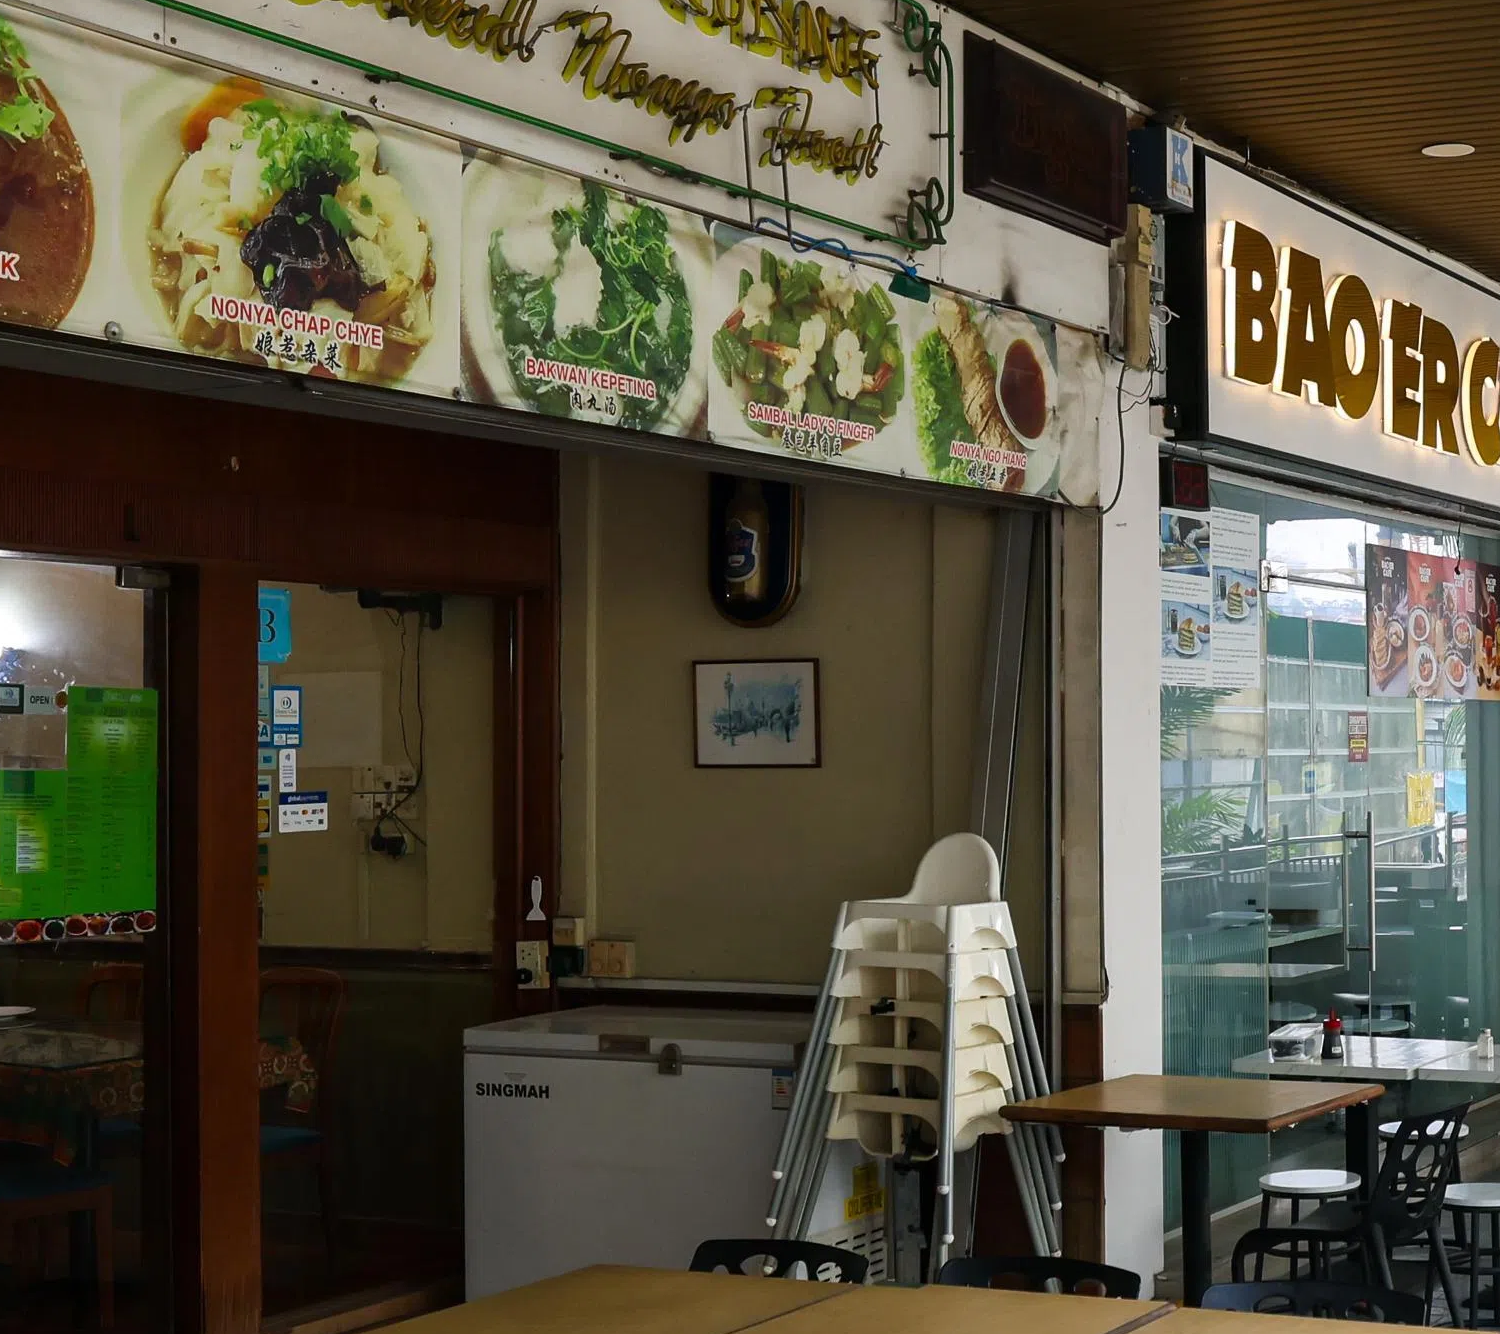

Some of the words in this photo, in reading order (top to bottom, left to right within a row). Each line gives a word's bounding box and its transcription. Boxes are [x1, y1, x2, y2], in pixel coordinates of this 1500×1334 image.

[754, 87, 884, 183] Food
[211, 296, 276, 327] NONYA
[279, 307, 330, 336] CHAP
[335, 320, 383, 347] CHYE
[254, 332, 343, 369] 娘惹杂菜
[525, 358, 588, 387] BAKWAN
[590, 371, 656, 399] KEPETING
[571, 391, 617, 415] 肉丸汤
[749, 402, 794, 425] SAMBAL
[796, 411, 836, 435] LADY'S
[837, 420, 876, 442] FINGER
[950, 441, 980, 459] NONYA
[981, 447, 1001, 463] NGO
[1002, 451, 1027, 467] HIANG
[30, 695, 51, 704] OPEN
[475, 1080, 550, 1099] SINGMAH
